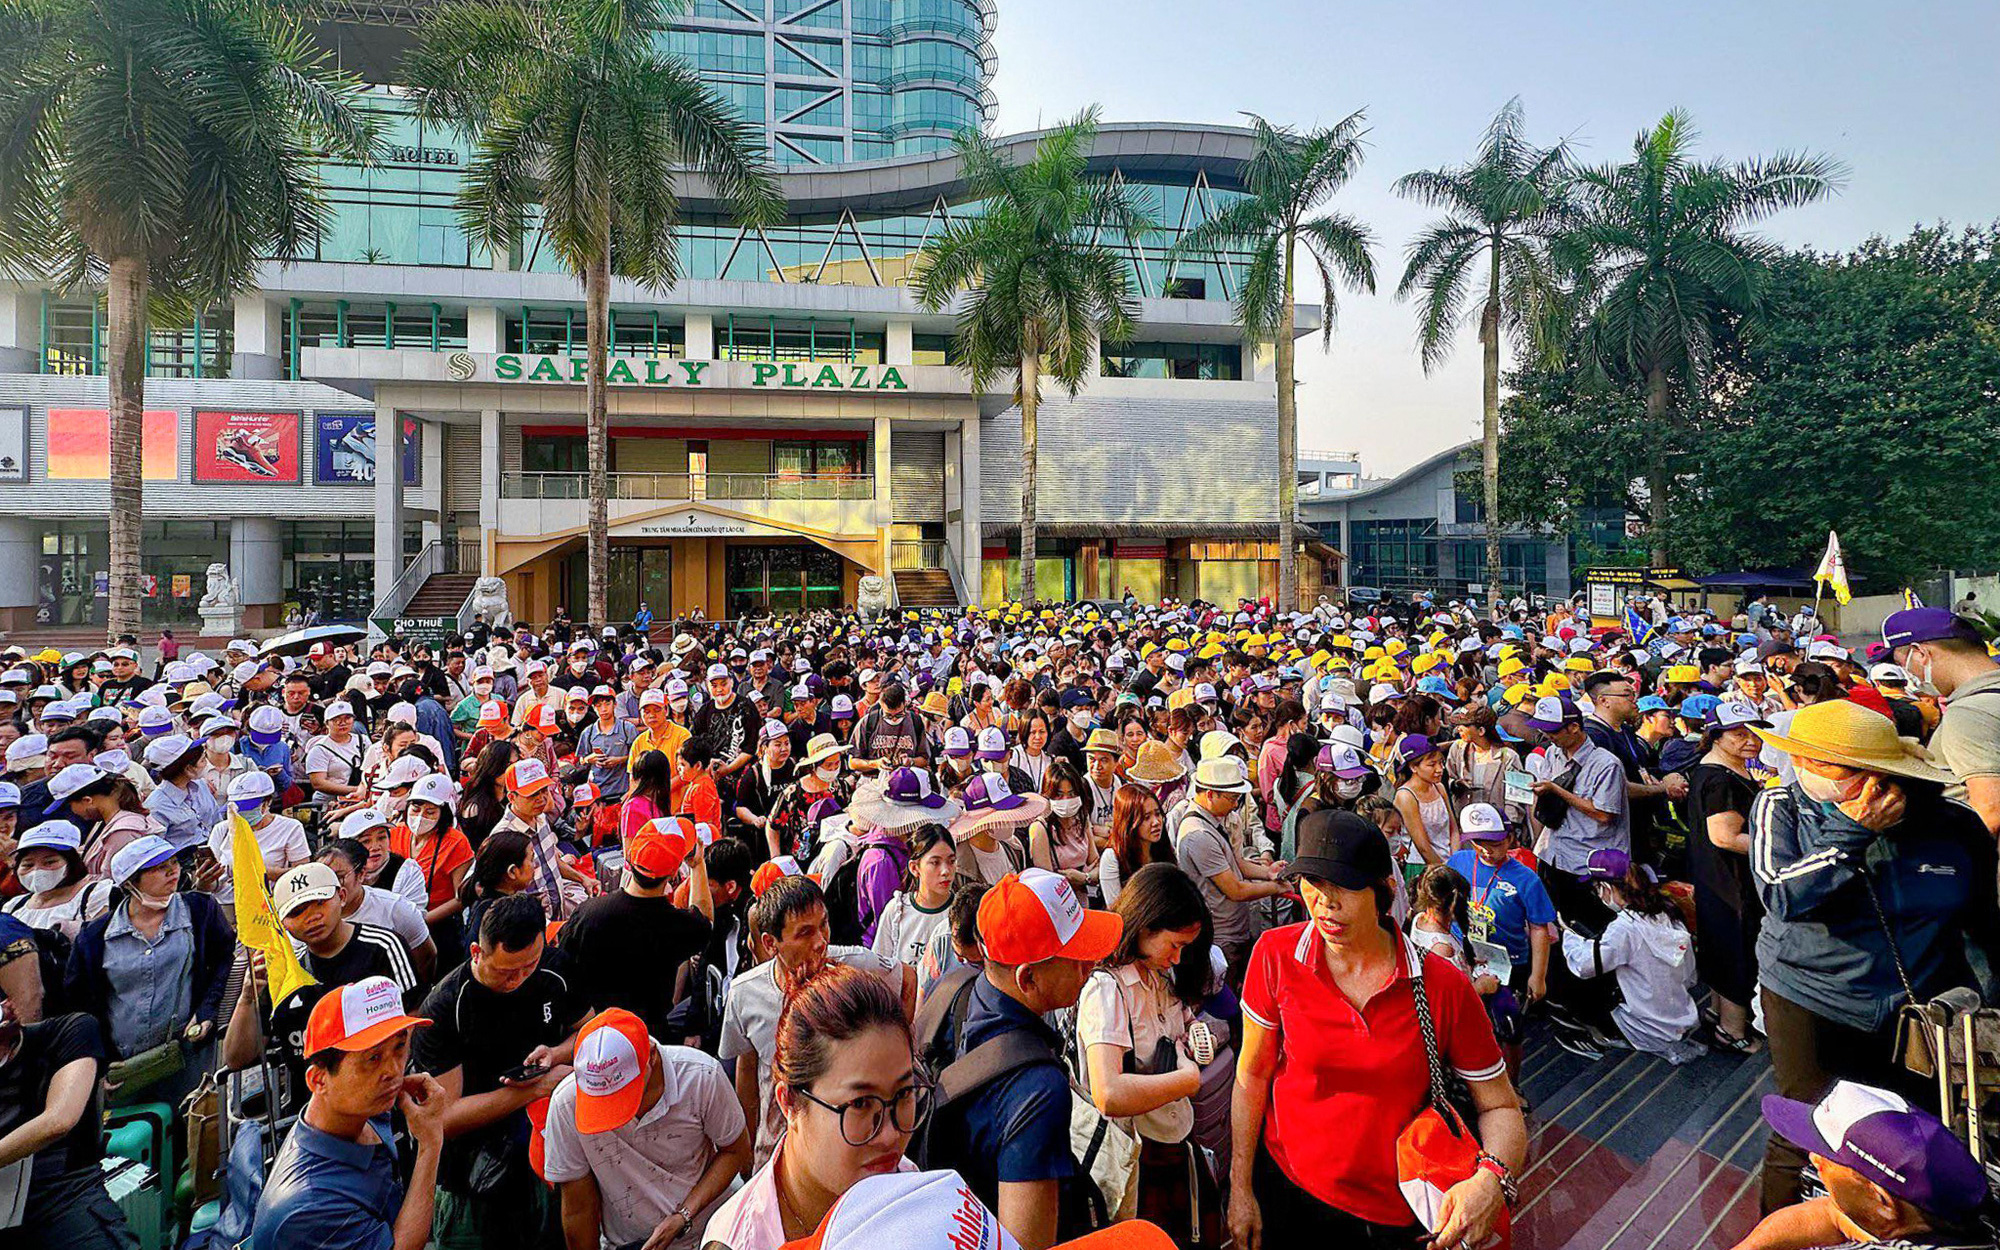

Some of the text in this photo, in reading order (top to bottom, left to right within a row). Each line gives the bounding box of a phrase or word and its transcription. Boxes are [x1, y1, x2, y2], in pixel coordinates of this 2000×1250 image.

[494, 355, 909, 390] SAPALY PLAZA
[394, 616, 443, 628] CHO THUÊ
